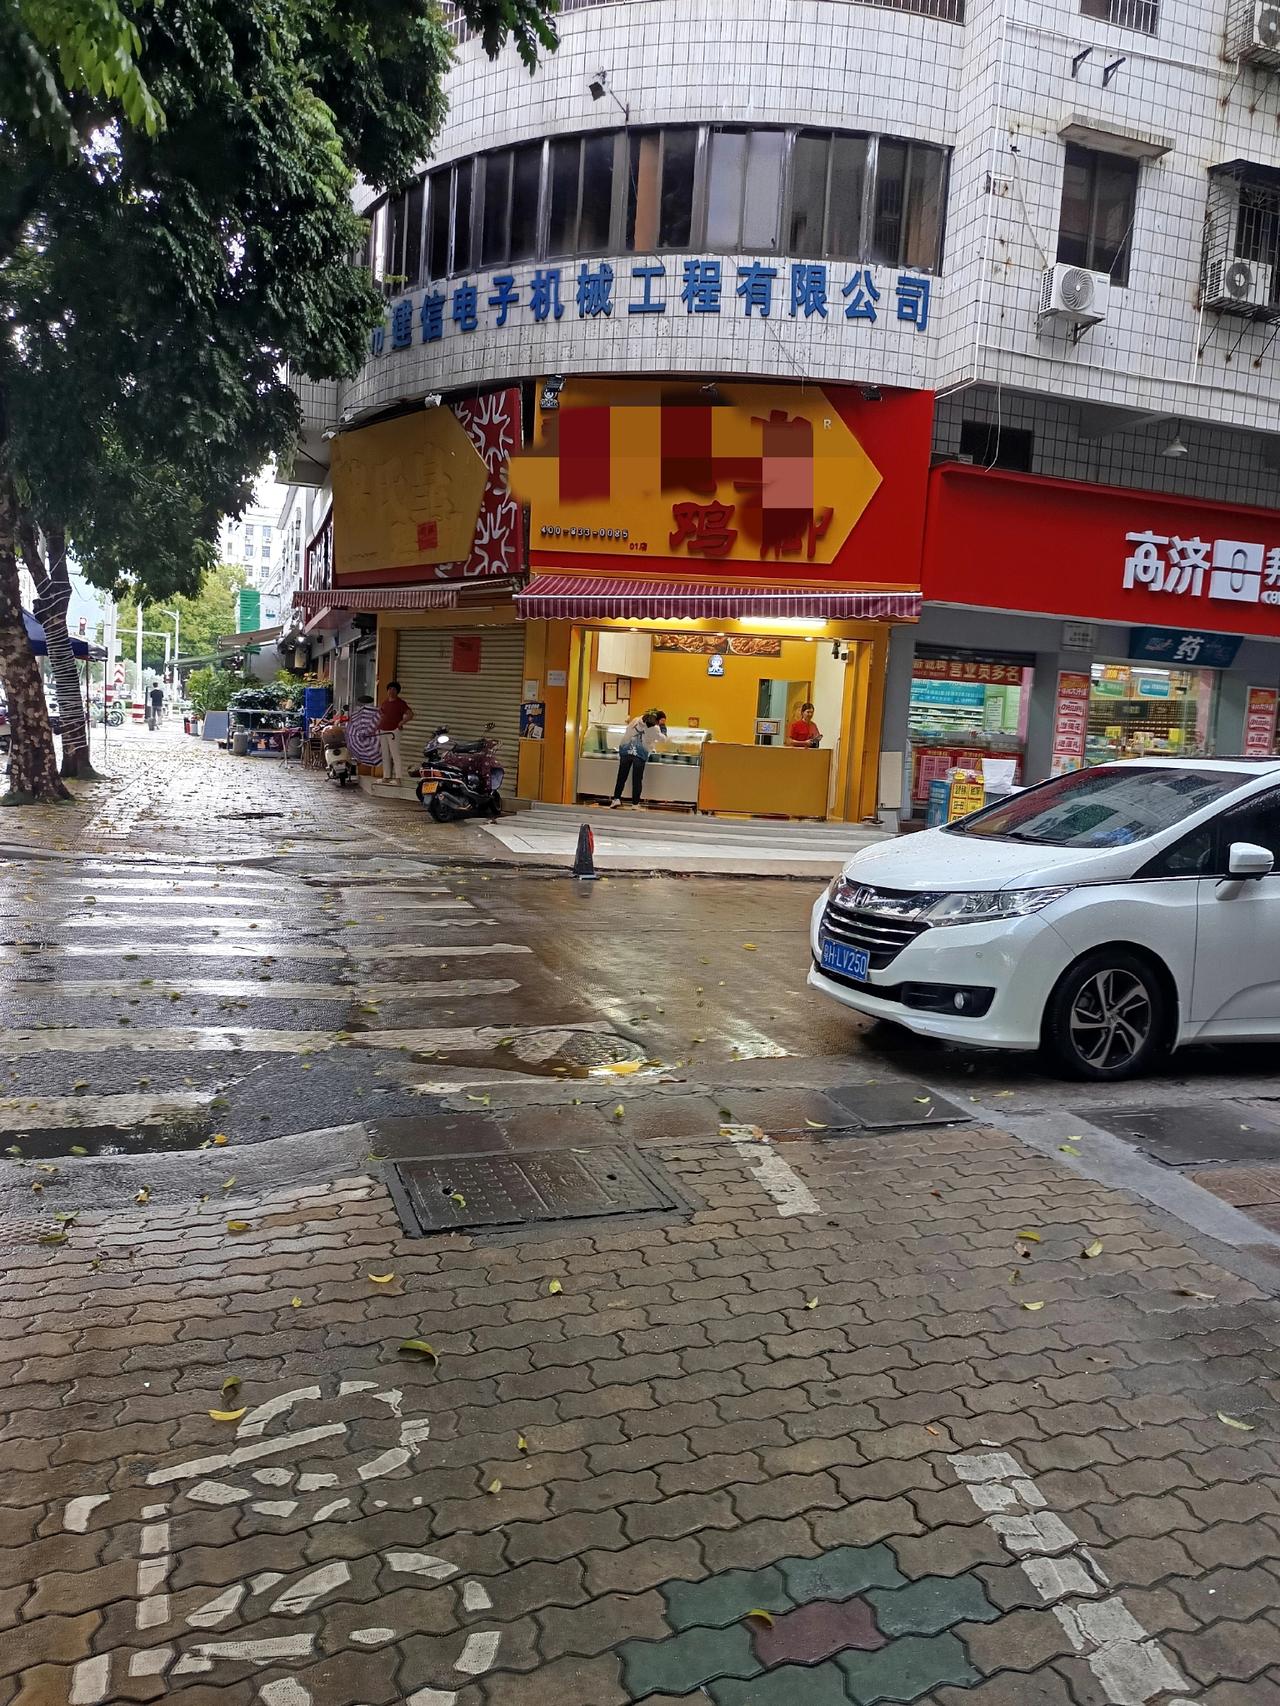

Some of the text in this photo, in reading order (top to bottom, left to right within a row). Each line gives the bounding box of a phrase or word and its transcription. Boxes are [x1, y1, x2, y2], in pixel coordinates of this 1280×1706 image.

[540, 526, 629, 540] 400-833-0085
[1123, 531, 1211, 596] 高济
[1173, 635, 1204, 662] 药
